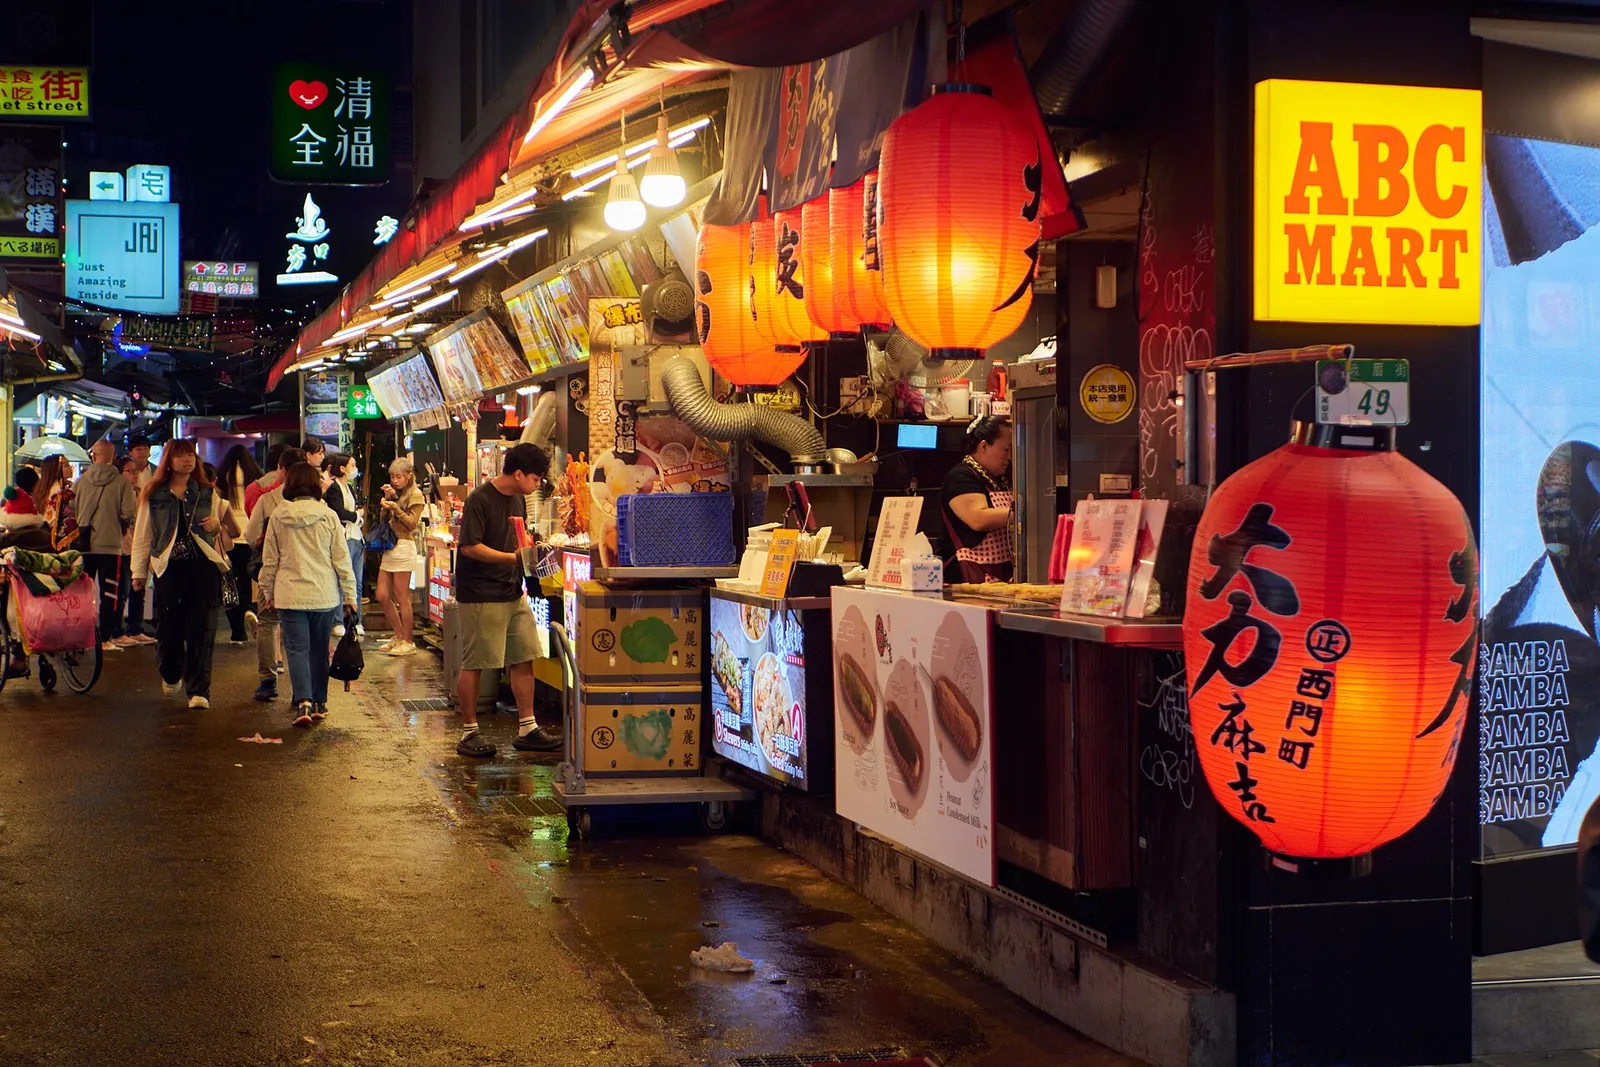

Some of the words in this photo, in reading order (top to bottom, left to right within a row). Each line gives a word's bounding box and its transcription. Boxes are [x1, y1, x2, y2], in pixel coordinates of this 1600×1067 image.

[40, 70, 83, 100] 街
[27, 101, 83, 111] street
[334, 77, 372, 119] 清
[1284, 121, 1468, 219] ABC
[141, 170, 164, 195] 宅
[0, 240, 57, 255] べる場所
[1284, 223, 1468, 289] MART
[78, 263, 104, 271] Just
[78, 276, 126, 288] Amazing
[78, 290, 118, 300] Inside
[1088, 385, 1127, 393] 本店免用
[1088, 394, 1127, 402] 統一發票
[1357, 389, 1391, 415] 49
[684, 609, 697, 669] 高麗菜
[1278, 667, 1335, 770] 西門町
[682, 707, 696, 767] 高麗菜
[897, 801, 909, 816] Sauce
[947, 806, 970, 825] Condensed
[970, 815, 981, 829] Milk
